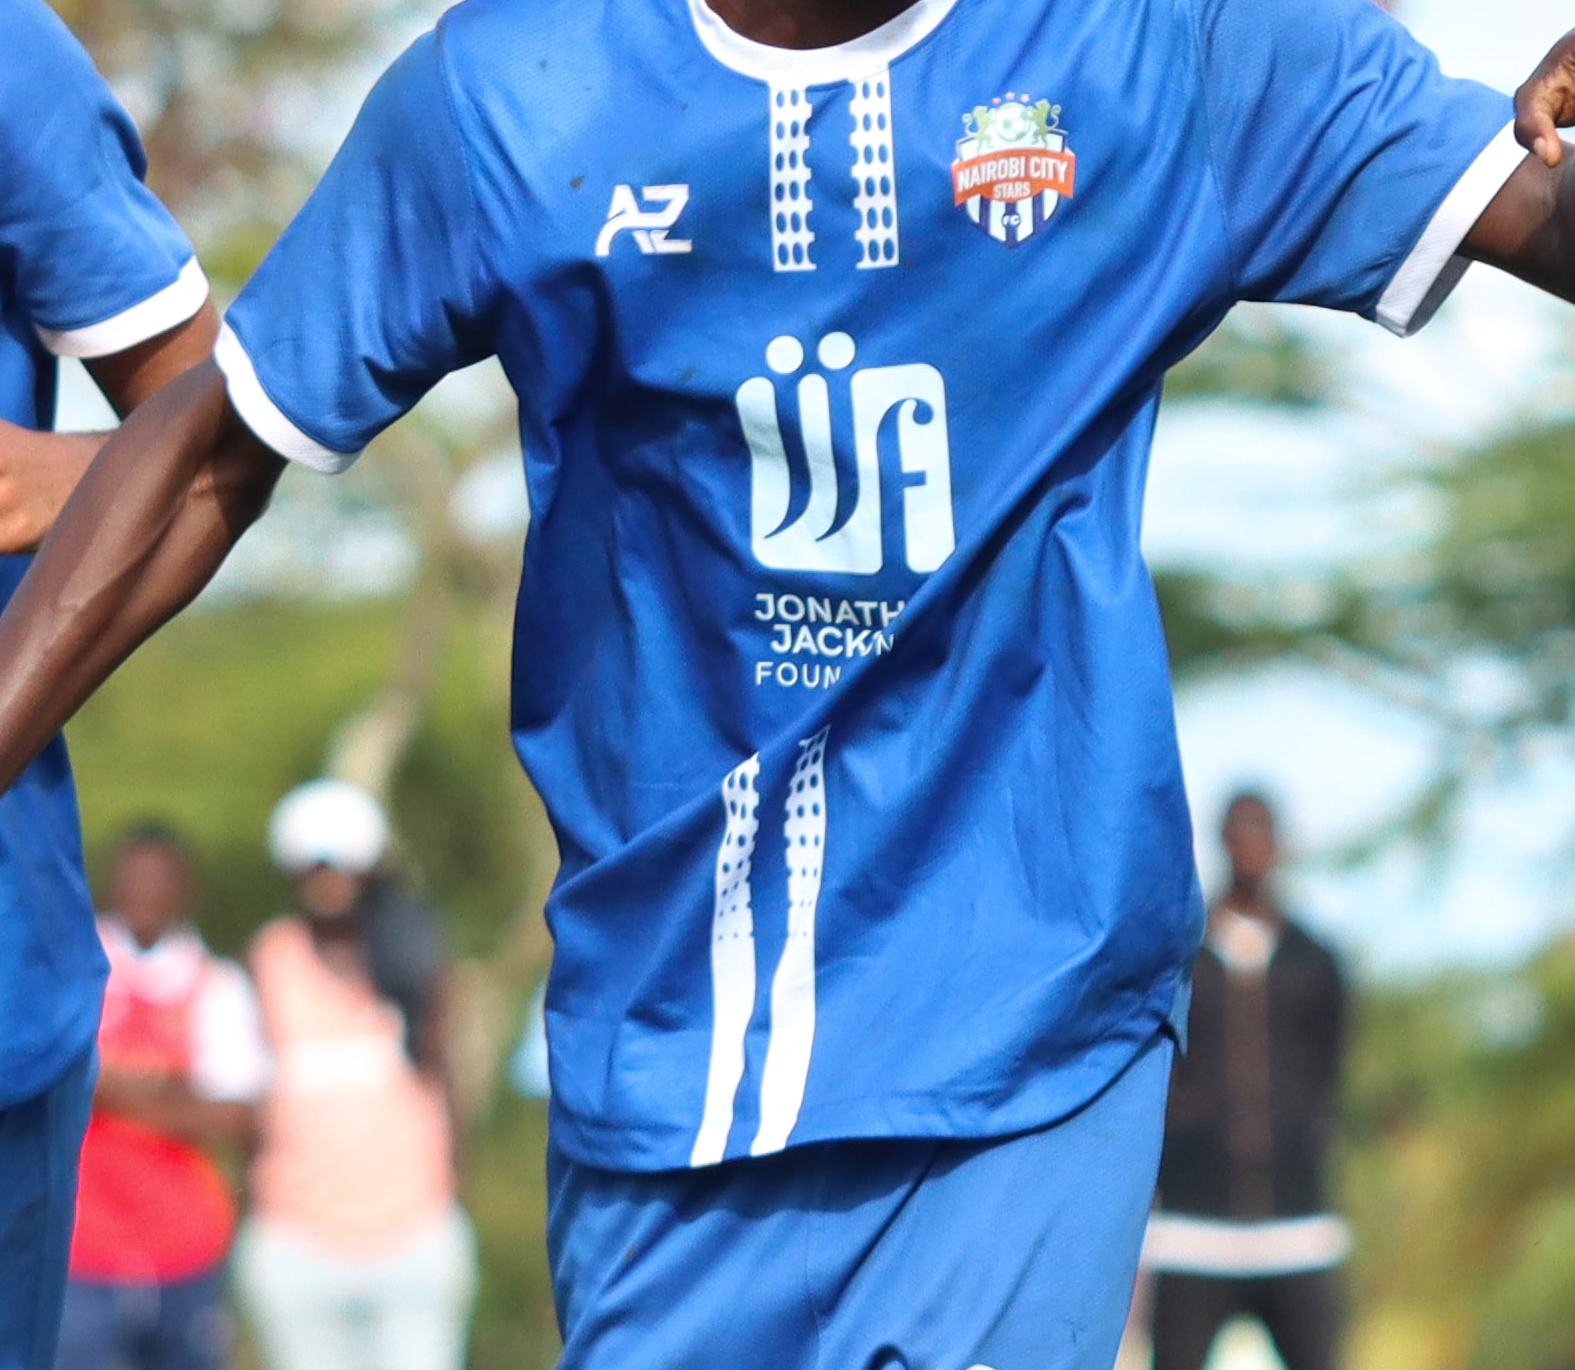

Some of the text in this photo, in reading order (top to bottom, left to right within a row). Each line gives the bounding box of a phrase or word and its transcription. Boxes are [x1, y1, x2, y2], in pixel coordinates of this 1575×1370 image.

[957, 156, 1068, 193] NAIROBI CITY
[993, 181, 1031, 198] STARS
[1002, 215, 1020, 226] FC
